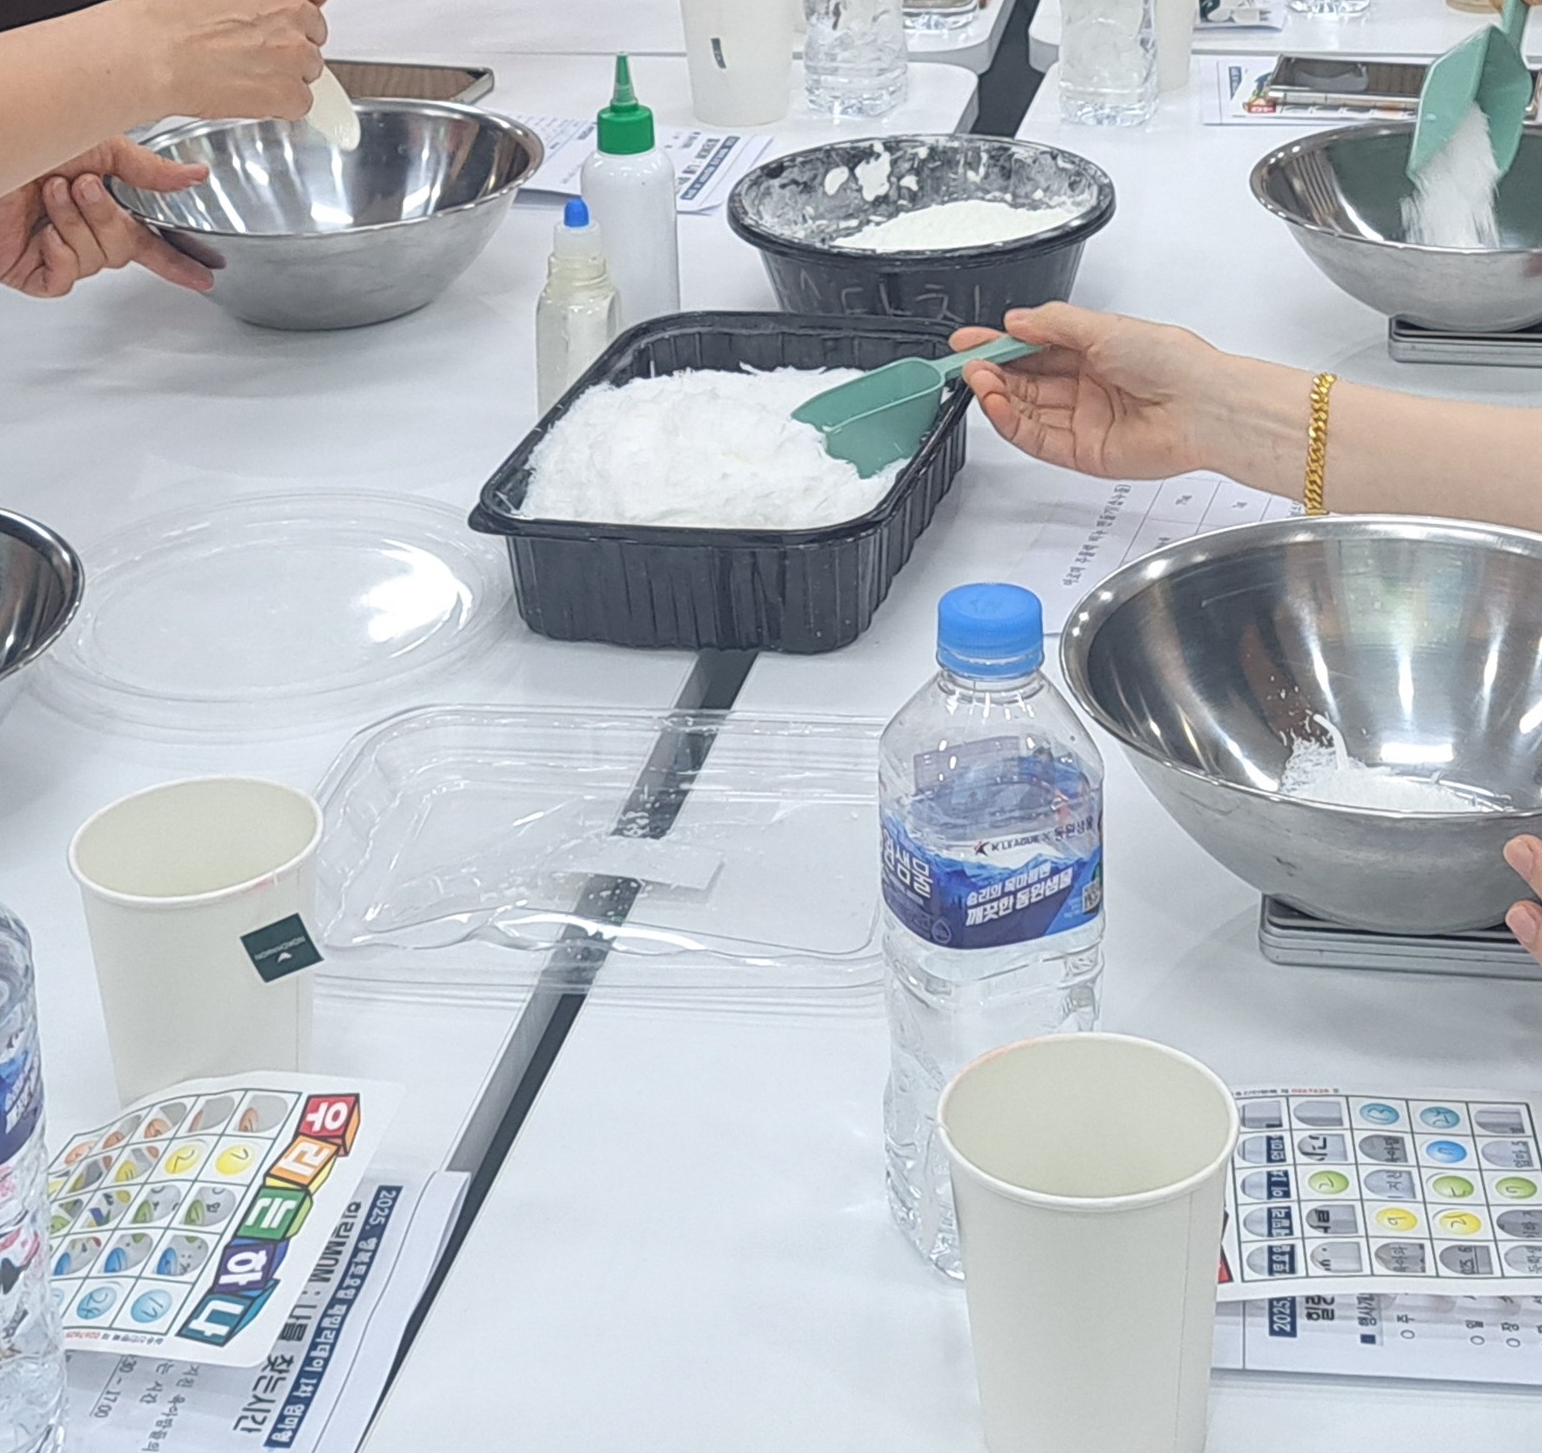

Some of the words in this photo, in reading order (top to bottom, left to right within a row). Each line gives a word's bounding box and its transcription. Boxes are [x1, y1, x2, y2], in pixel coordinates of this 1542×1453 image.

[991, 842, 998, 851] K
[1001, 835, 1039, 849] LEAGUE
[1054, 815, 1093, 840] 동원샘물
[965, 899, 1013, 926] 깨끗한
[1015, 867, 1073, 909] 동원샘물
[966, 883, 1001, 905] 승리의
[367, 1188, 398, 1232] 2025.
[333, 1235, 380, 1302] 행복토요일
[305, 1301, 344, 1372] 패밀리데이
[94, 1390, 120, 1419] 17:00
[139, 1381, 163, 1405] 시간
[272, 1401, 305, 1443] 엄마형
